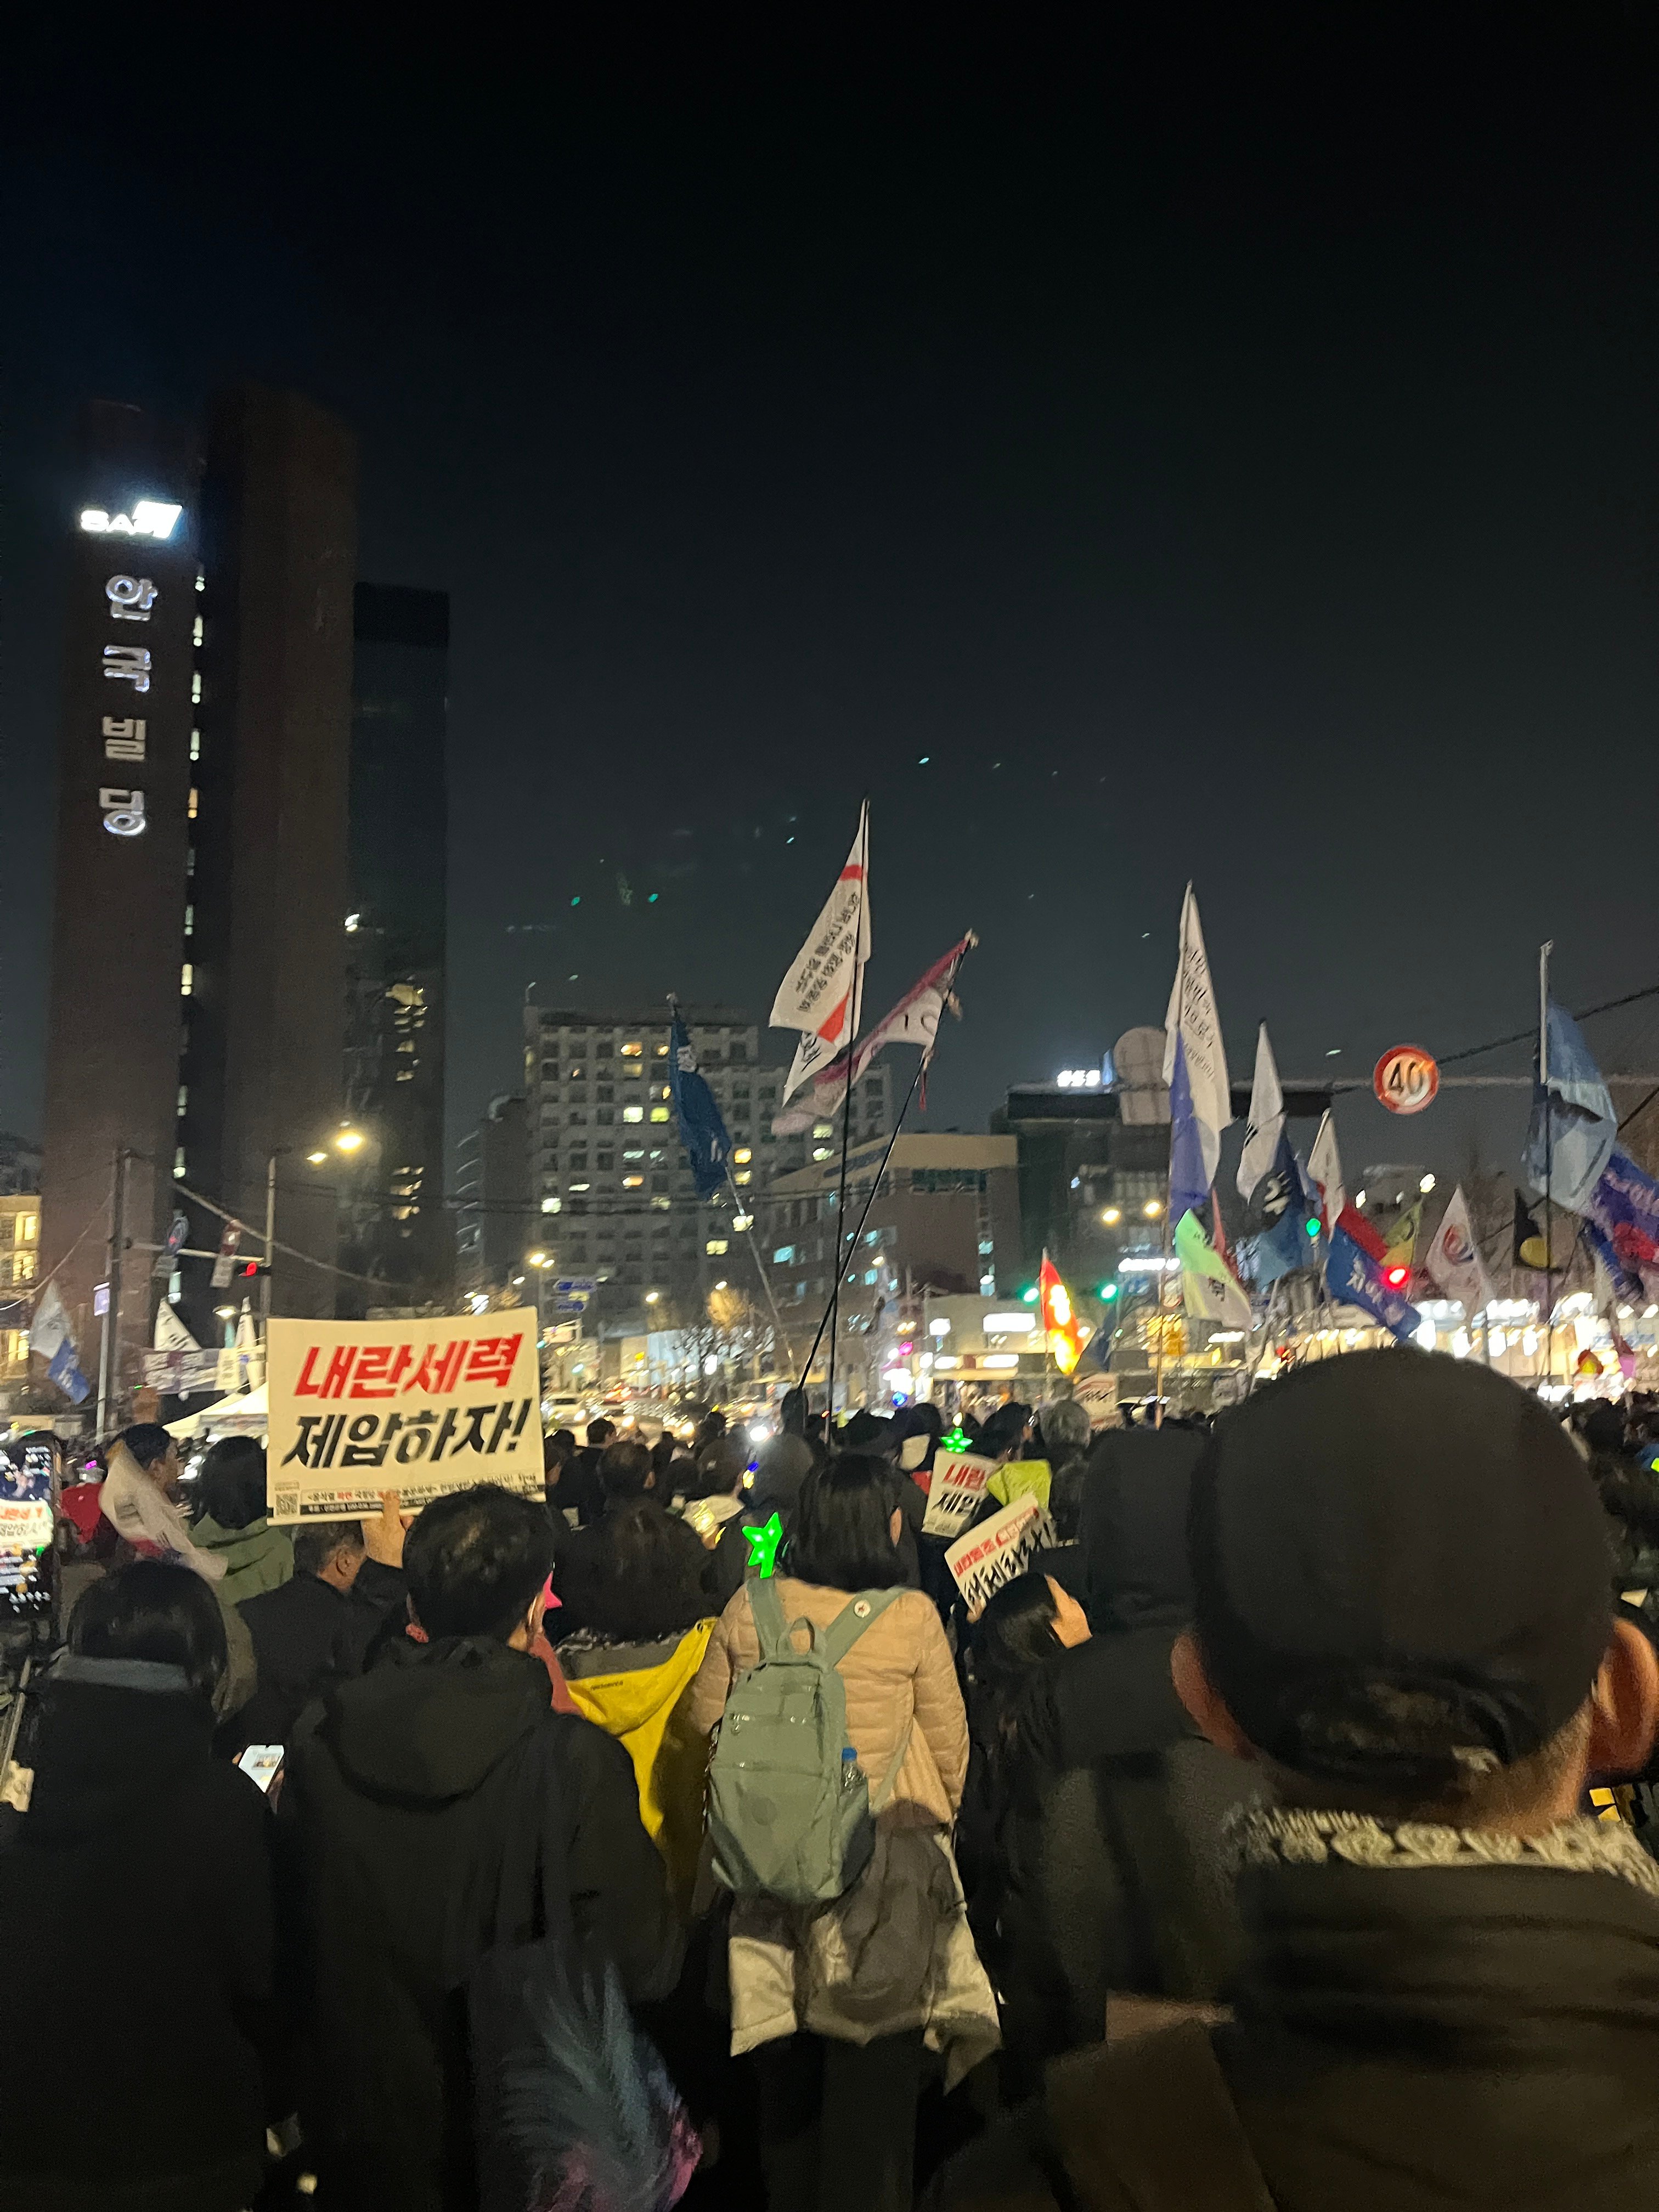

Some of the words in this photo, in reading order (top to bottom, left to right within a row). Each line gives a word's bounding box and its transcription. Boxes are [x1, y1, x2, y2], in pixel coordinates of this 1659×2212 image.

[1388, 1060, 1424, 1096] 40
[294, 1333, 524, 1399] 내란세력
[280, 1398, 533, 1469] 제압하자!
